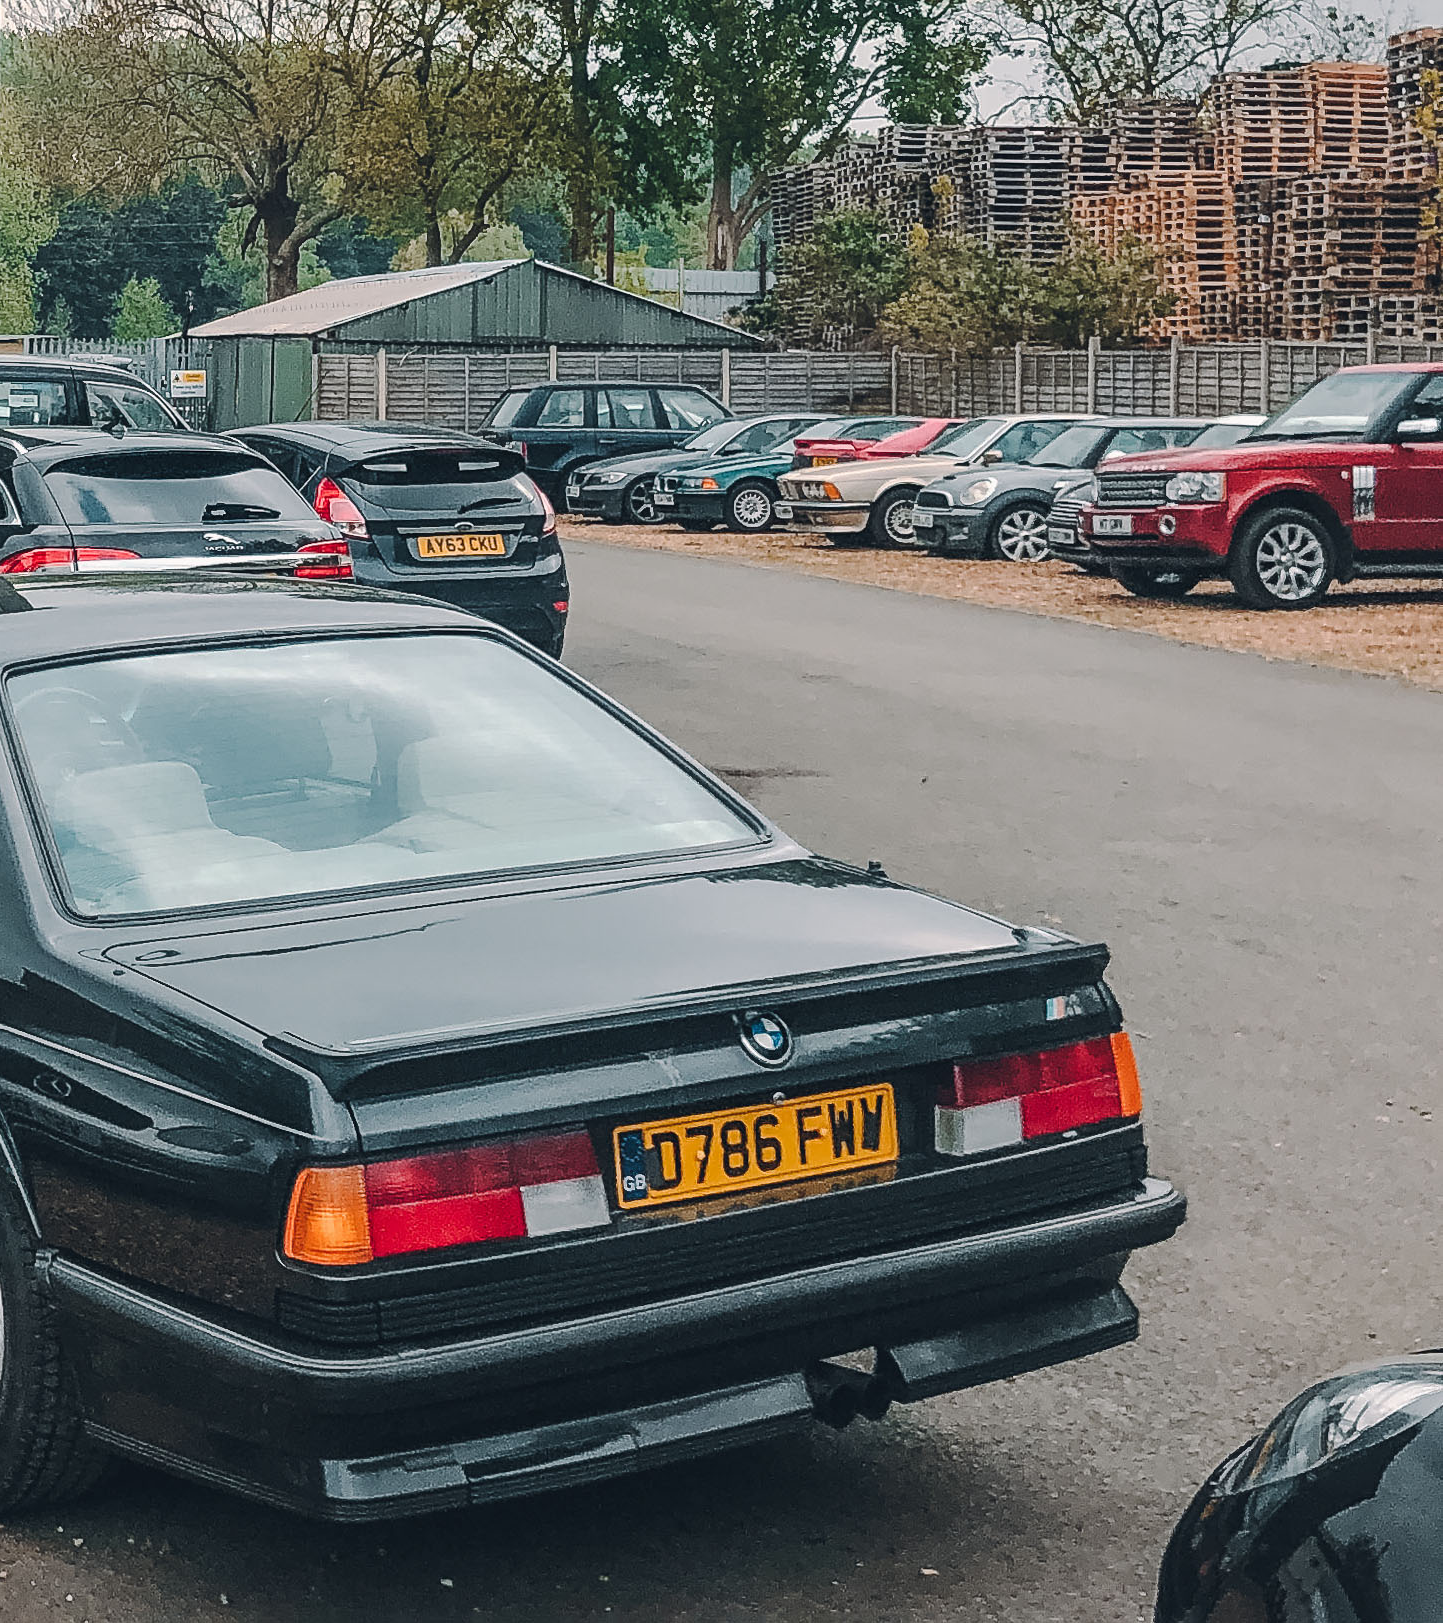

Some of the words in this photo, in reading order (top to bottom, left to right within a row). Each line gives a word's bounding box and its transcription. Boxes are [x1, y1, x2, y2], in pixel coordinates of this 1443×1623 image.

[426, 537, 466, 554] AY63
[469, 535, 498, 552] CKU
[650, 1112, 784, 1192] D786
[622, 1173, 647, 1193] GB
